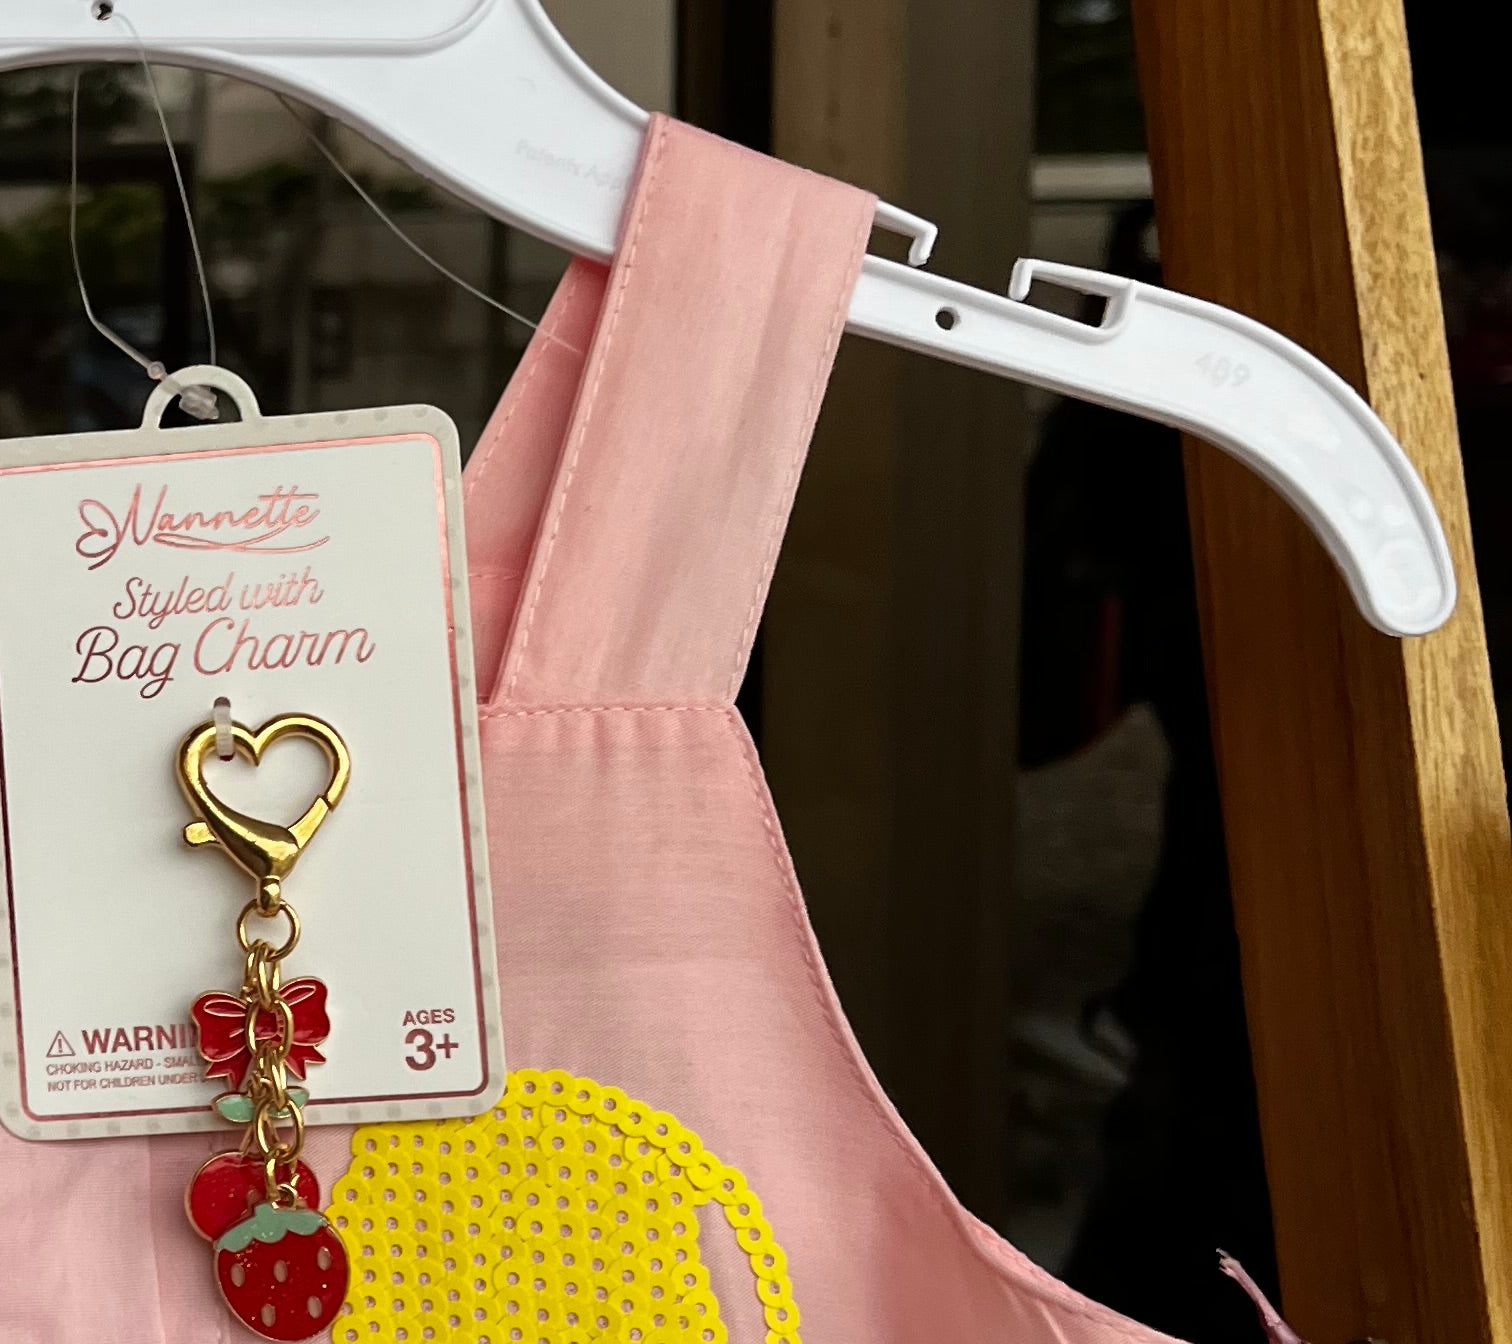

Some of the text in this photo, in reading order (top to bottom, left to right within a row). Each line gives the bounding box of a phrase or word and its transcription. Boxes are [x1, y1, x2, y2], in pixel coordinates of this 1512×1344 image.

[75, 483, 330, 570] Nannette
[113, 566, 324, 630] Styled with
[72, 617, 376, 699] Bag Charm
[402, 1008, 456, 1028] AGES
[82, 1023, 197, 1055] WARNI
[404, 1027, 460, 1071] 3+
[46, 1061, 102, 1076] CHOKING
[104, 1057, 154, 1072] HAZARD
[164, 1055, 200, 1068] SMAL
[47, 1079, 72, 1093] NOT
[74, 1078, 97, 1090] FOR
[99, 1074, 155, 1089] CHILDREN
[158, 1072, 198, 1085] UNDER
